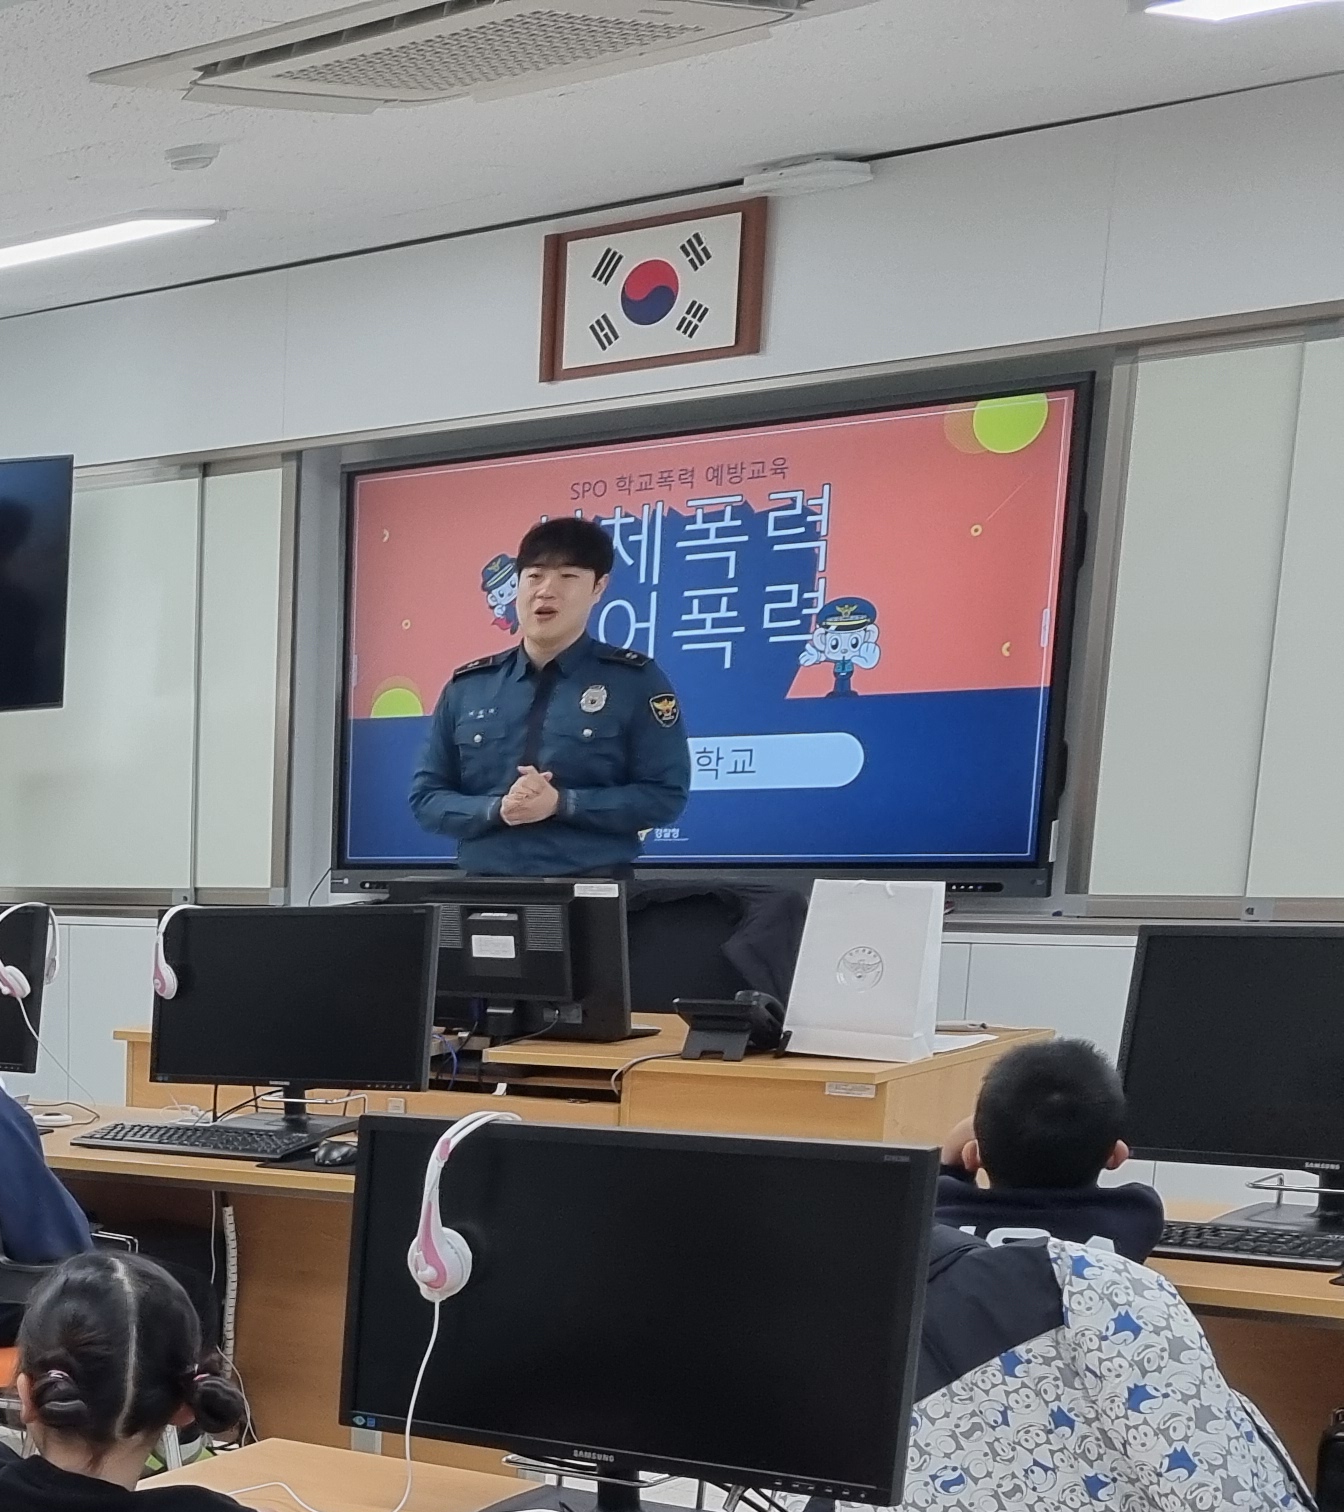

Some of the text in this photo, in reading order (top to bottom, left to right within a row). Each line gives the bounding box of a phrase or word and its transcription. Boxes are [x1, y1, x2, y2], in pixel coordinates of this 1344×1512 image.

[570, 456, 790, 500] SPO 학교폭력 예방교육
[540, 483, 832, 586] 체폭력
[695, 746, 757, 780] 학교
